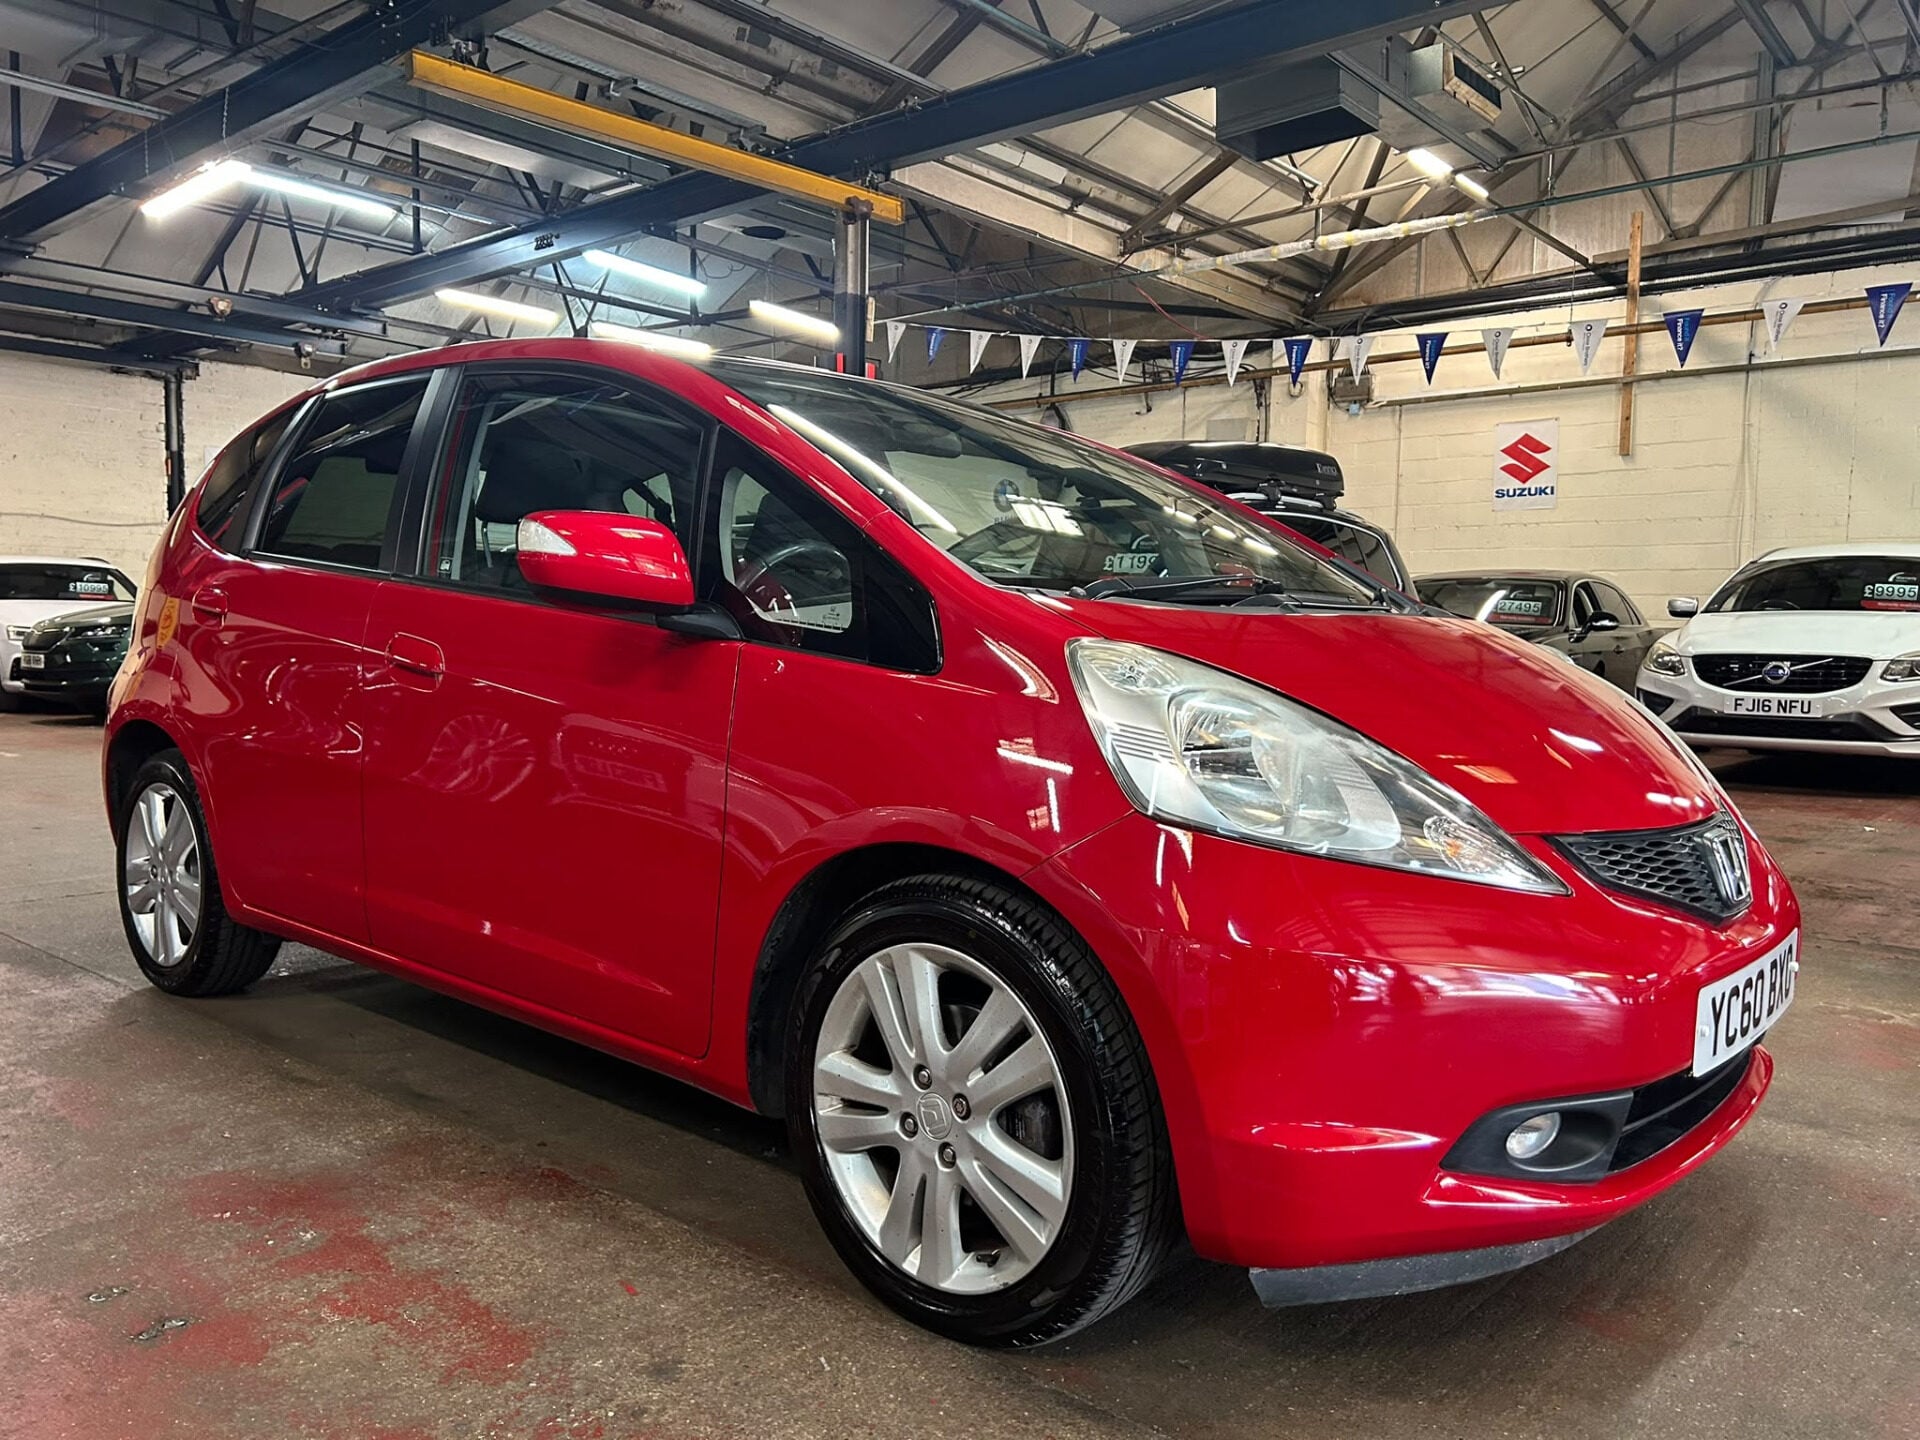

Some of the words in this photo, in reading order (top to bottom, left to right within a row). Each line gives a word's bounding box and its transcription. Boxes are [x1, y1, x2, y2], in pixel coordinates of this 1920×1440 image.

[1879, 293, 1888, 318] Finance
[1495, 486, 1554, 498] SUZUKI
[1864, 585, 1917, 598] £9995
[1734, 698, 1772, 713] FJ16
[1776, 699, 1812, 714] NFU
[1711, 968, 1765, 1057] YC60
